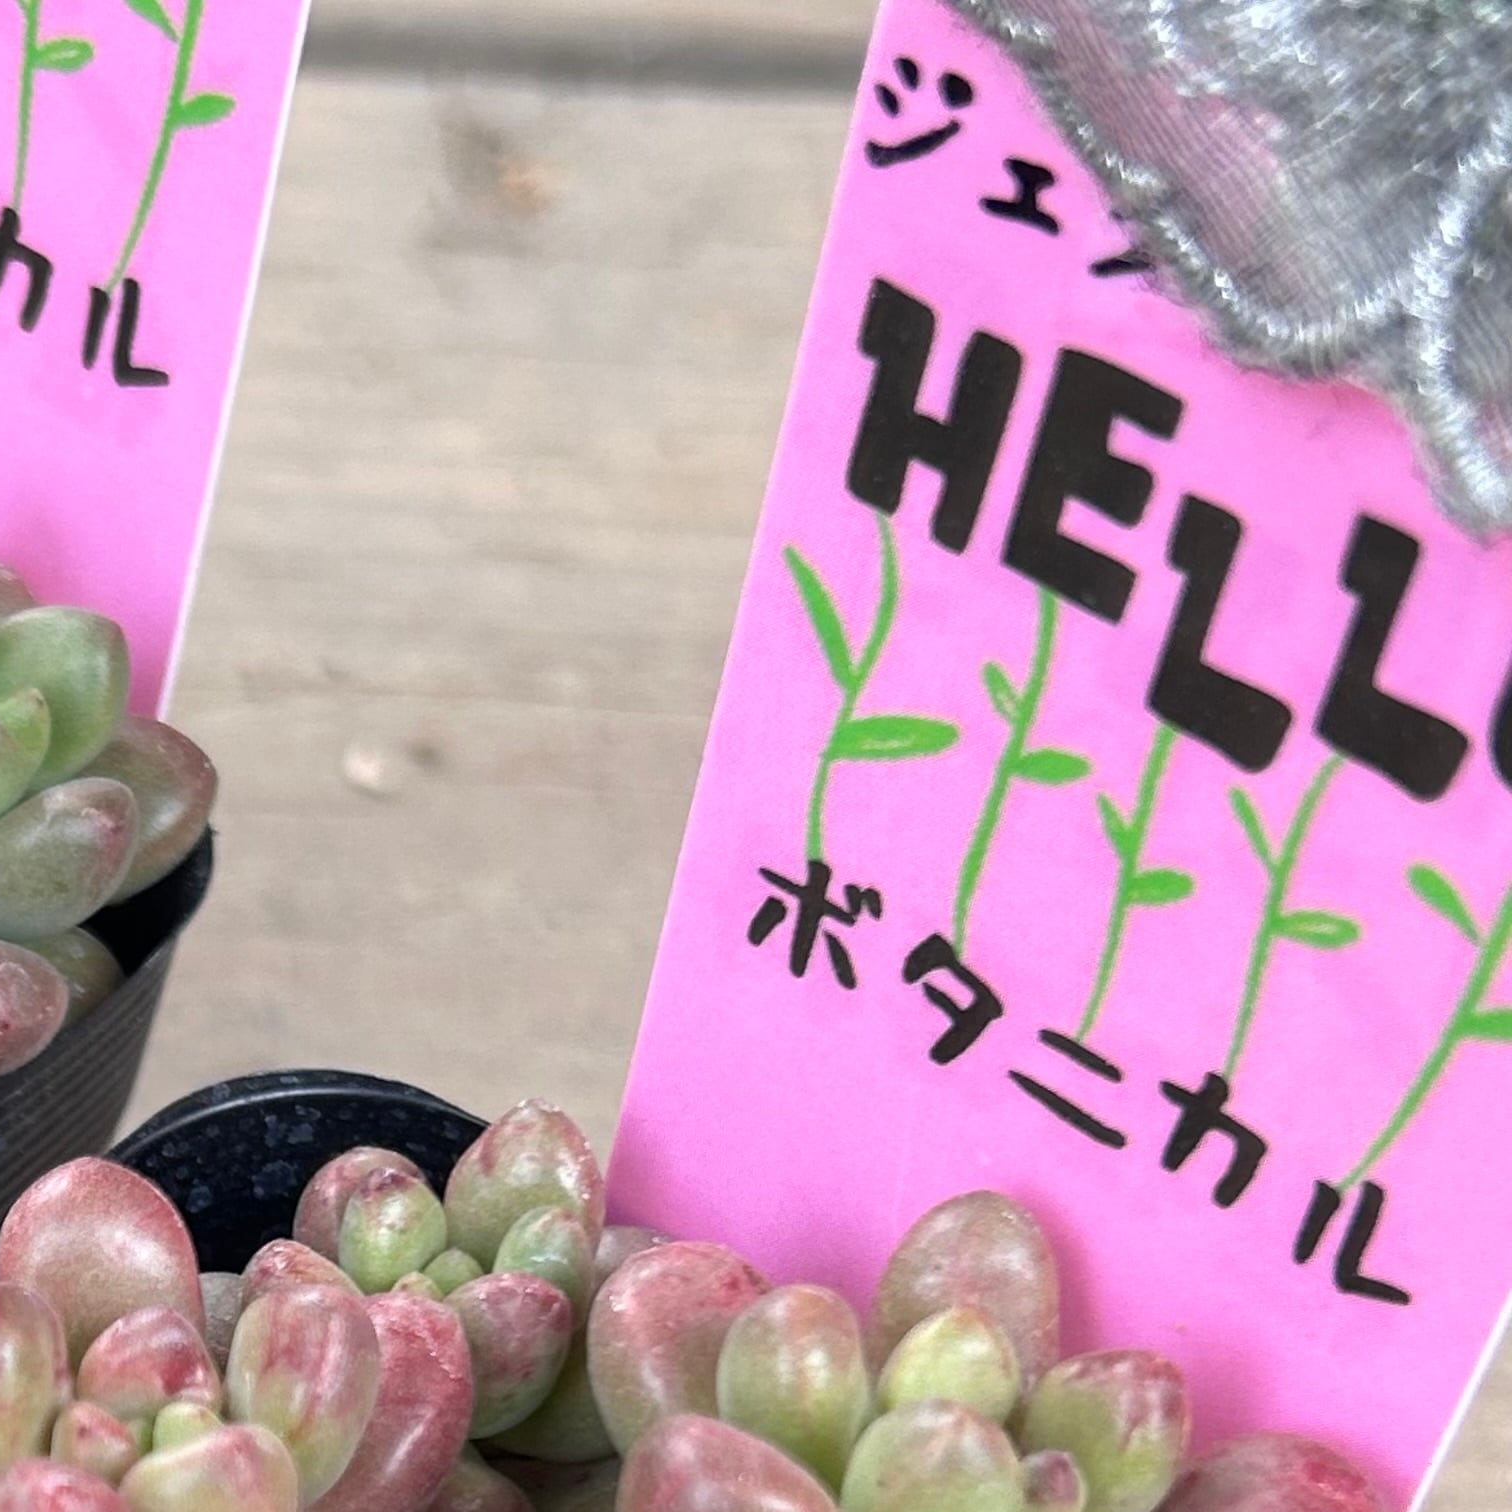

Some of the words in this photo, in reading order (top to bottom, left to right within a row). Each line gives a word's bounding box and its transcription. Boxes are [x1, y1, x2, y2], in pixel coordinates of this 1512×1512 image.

[864, 56, 1154, 277] ジェ
[845, 276, 1512, 803] HELL
[747, 859, 1412, 1305] ボタニカル
